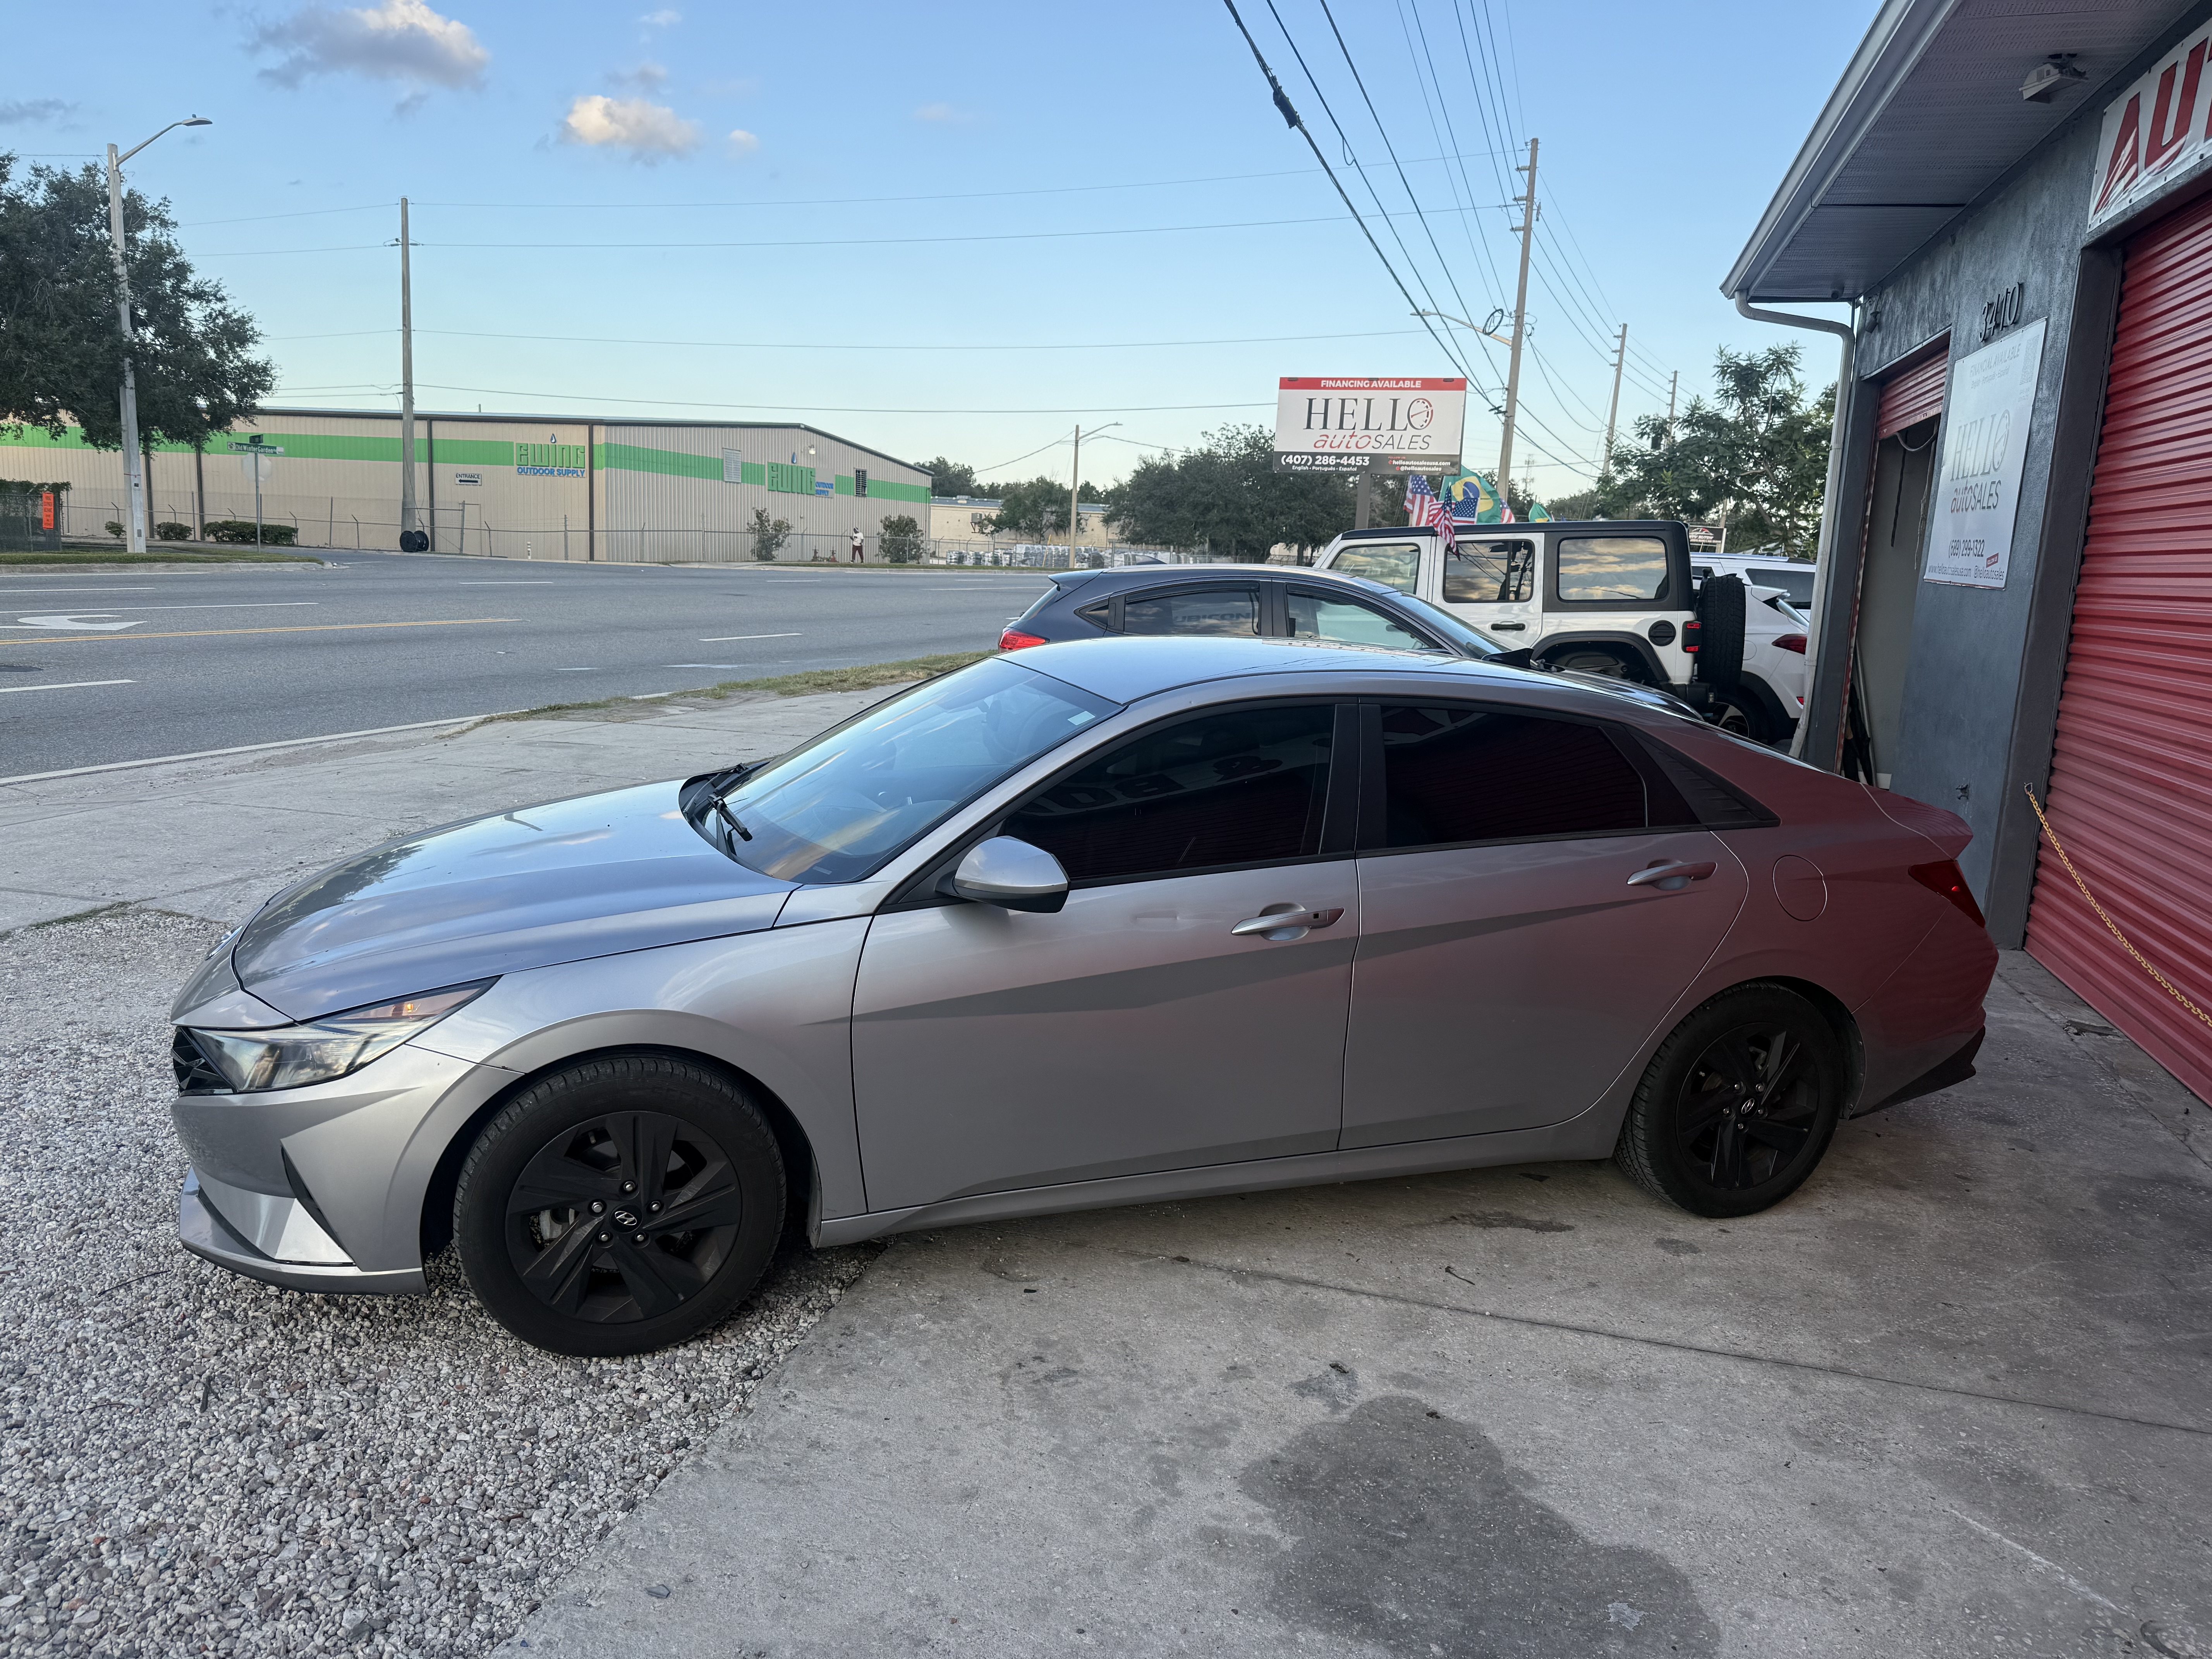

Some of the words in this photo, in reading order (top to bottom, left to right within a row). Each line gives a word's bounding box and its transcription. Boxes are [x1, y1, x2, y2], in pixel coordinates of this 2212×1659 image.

[2093, 36, 2212, 216] AU
[1979, 280, 2021, 342] 3410
[1993, 343, 2021, 368] AVAILABLE
[1303, 398, 1434, 431] HELLO
[1950, 409, 2010, 481] HELLO
[1281, 455, 1312, 465] (407)
[1315, 455, 1370, 465] 286-4453
[517, 467, 555, 475] OUTDOOR
[556, 469, 585, 477] SUPPLY
[816, 481, 834, 489] OUTDOOR
[1949, 539, 1961, 558] (689)
[1961, 539, 1985, 557] 299-1322
[1974, 565, 2004, 580] @helloautosales
[1173, 612, 1252, 622] UBICON
